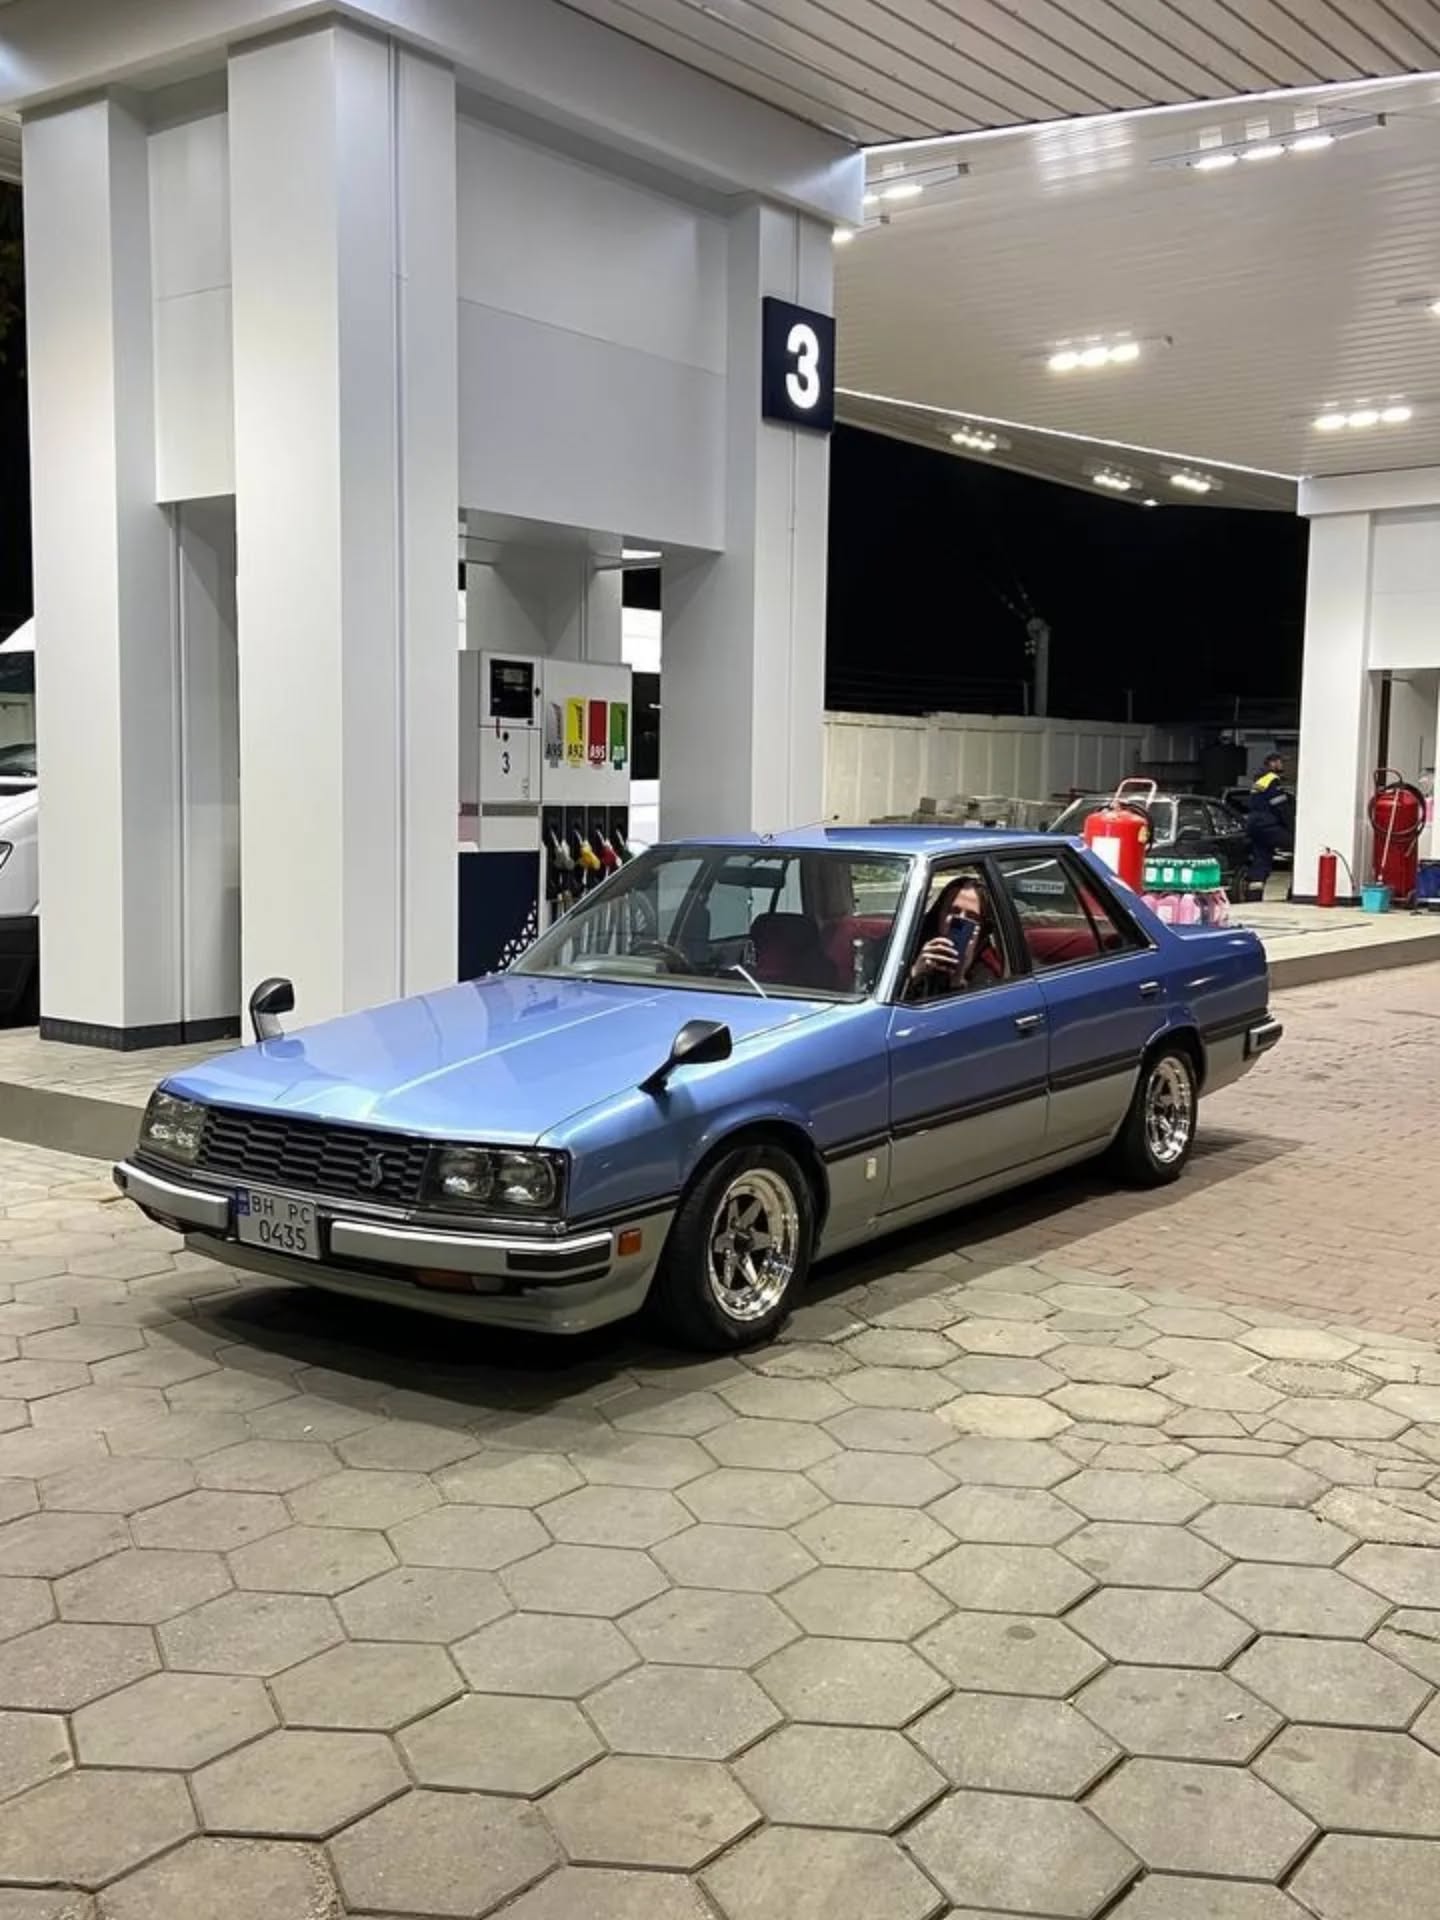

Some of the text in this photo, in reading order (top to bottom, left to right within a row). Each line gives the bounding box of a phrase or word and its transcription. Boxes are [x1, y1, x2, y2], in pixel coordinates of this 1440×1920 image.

[786, 323, 820, 409] 3
[502, 751, 511, 774] 3
[567, 743, 584, 758] A92
[590, 744, 606, 759] A95
[251, 1195, 274, 1216] BH
[288, 1203, 312, 1224] PC
[259, 1219, 306, 1250] 0435
